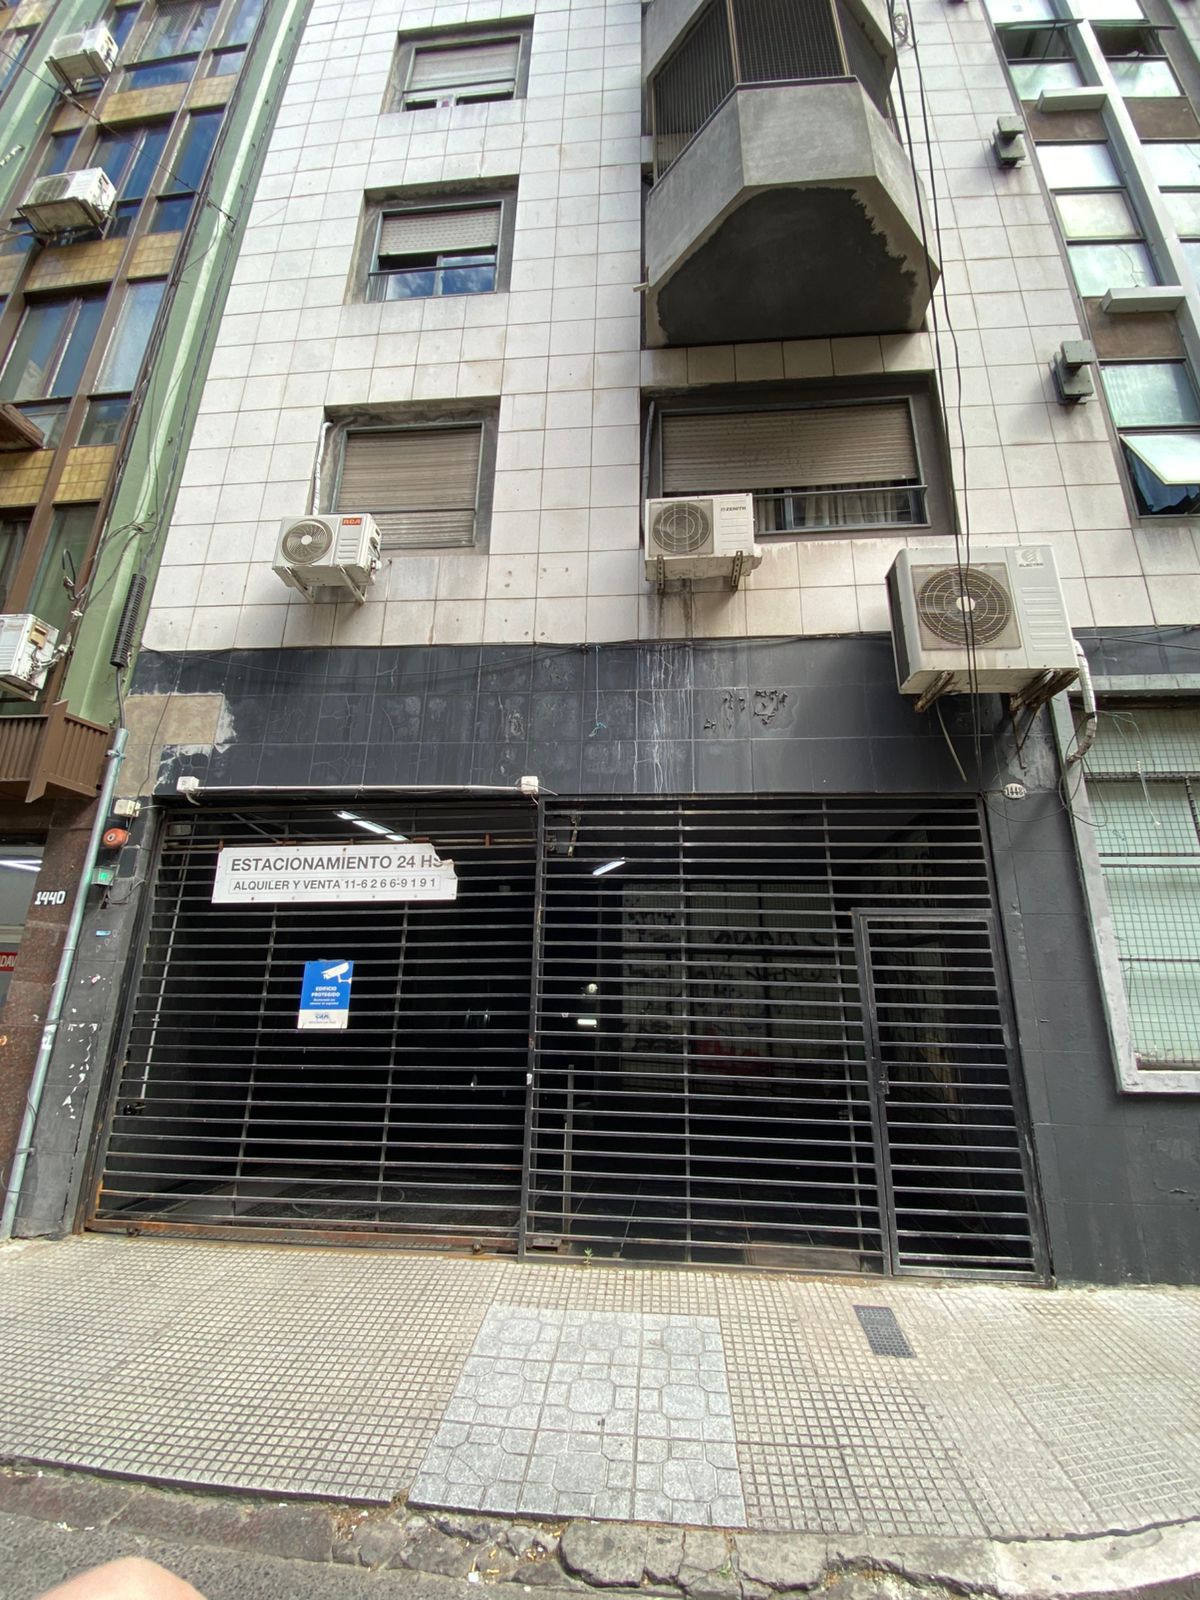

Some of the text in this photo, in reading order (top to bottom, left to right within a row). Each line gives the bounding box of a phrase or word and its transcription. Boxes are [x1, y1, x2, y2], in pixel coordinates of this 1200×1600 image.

[231, 856, 392, 872] ESTACIONAMIENTO
[397, 855, 416, 869] 24
[233, 880, 290, 891] ALQUILER
[293, 880, 300, 890] Y
[303, 879, 341, 890] VENTA
[34, 890, 66, 905] 1440
